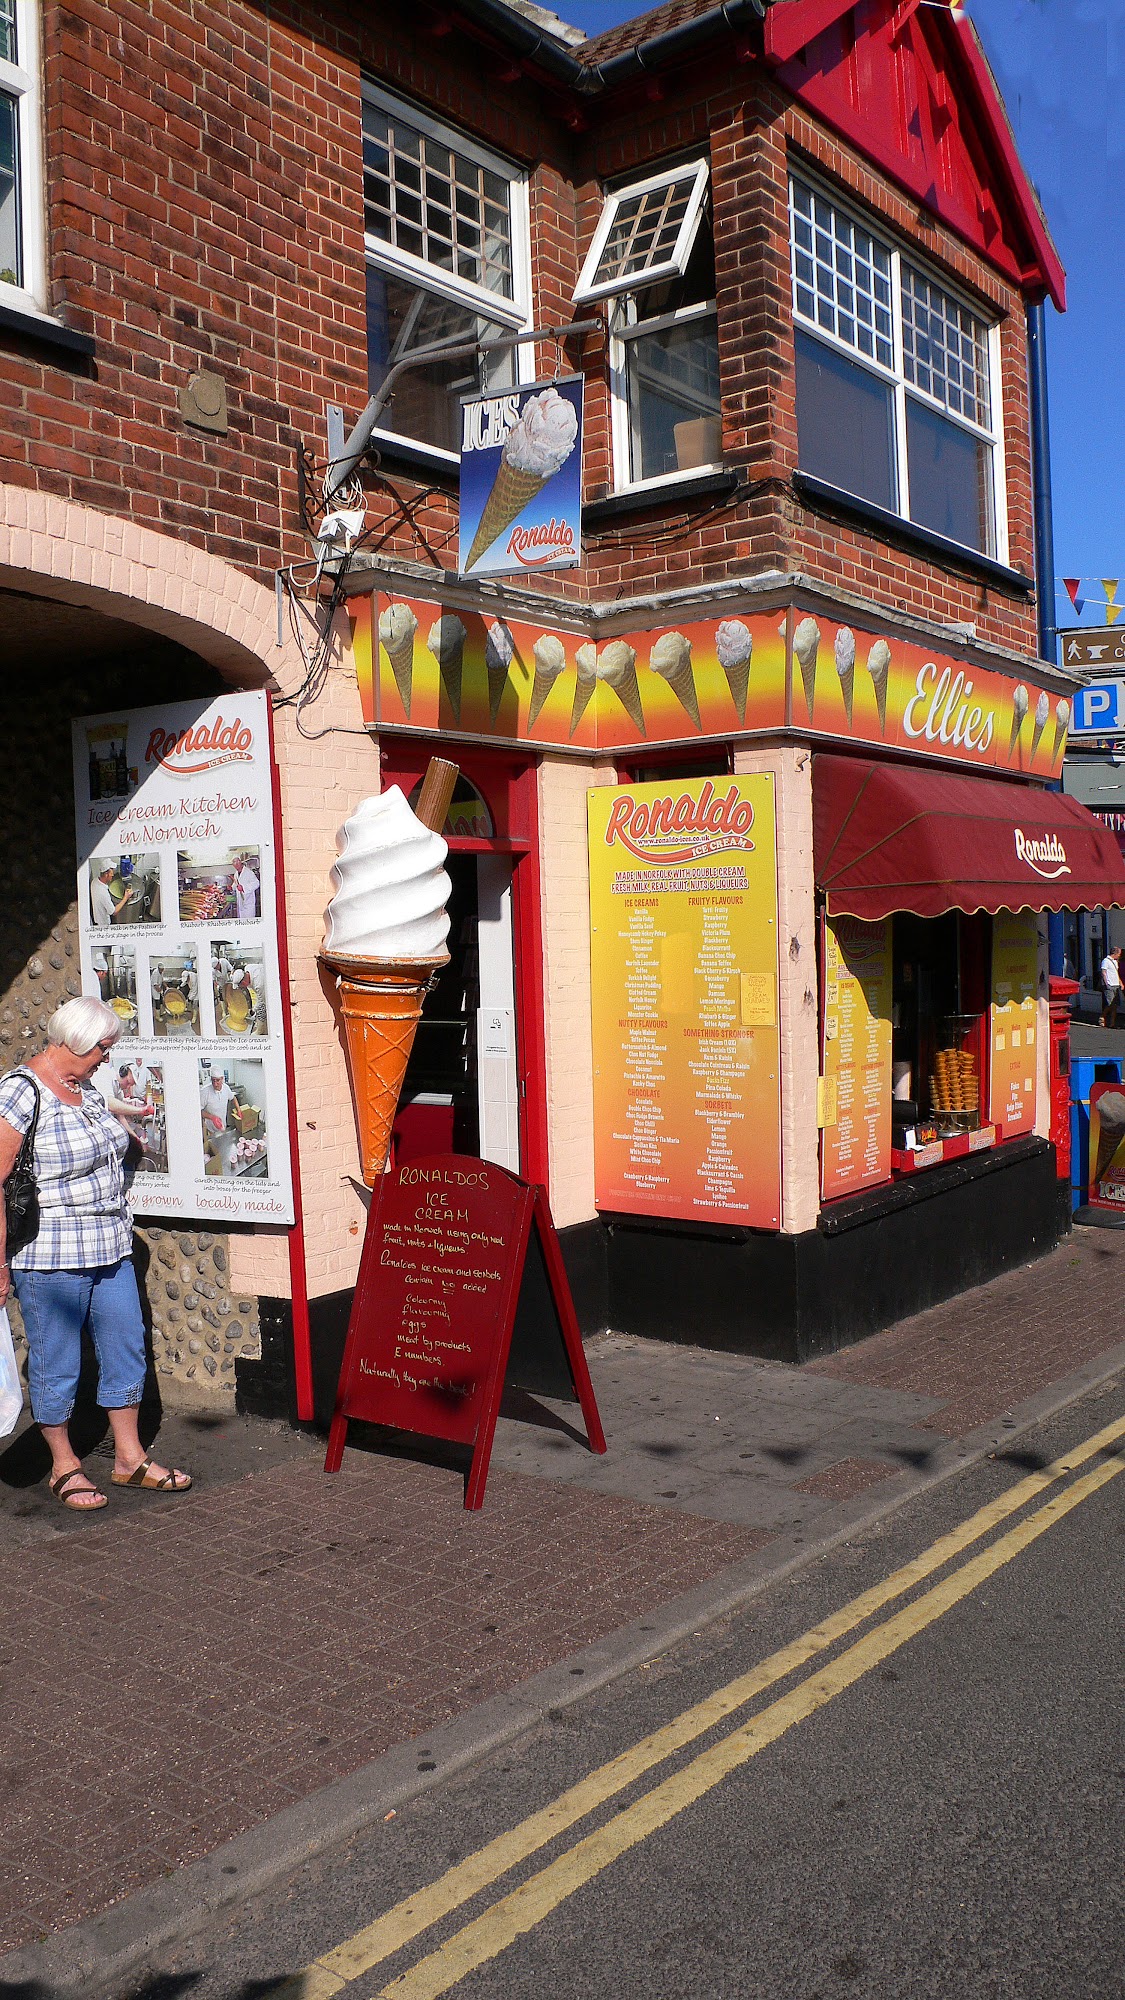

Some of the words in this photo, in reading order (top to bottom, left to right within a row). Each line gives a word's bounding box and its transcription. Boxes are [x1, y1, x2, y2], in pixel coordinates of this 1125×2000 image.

[462, 394, 520, 452] ICES
[507, 518, 574, 554] Ronaldo
[903, 663, 994, 753] Ellies
[1083, 690, 1110, 726] P
[145, 715, 253, 763] Ronaldo
[208, 759, 220, 768] ICE
[221, 752, 249, 764] CREAM
[88, 809, 113, 824] Ice
[117, 805, 177, 821] Cream
[179, 793, 256, 814] Kitchen
[604, 780, 754, 845] Ronaldo
[119, 829, 140, 844] in
[142, 818, 221, 842] Norwich
[637, 834, 710, 846] www.ronaldo-ices.co.uk
[691, 844, 708, 857] ICE
[710, 838, 747, 851] CREAM
[1014, 828, 1067, 863] Ronaldo
[615, 871, 634, 881] MADE
[635, 871, 642, 880] IN
[643, 869, 673, 880] NORFOLK
[673, 868, 691, 879] WITH
[692, 868, 717, 878] DOUBLE
[718, 867, 745, 877] CREAM
[611, 883, 631, 893] FRESH
[632, 882, 650, 893] MILK,
[651, 881, 668, 891] REAL
[669, 881, 690, 891] FRUIT,
[691, 880, 708, 890] NUTS
[709, 880, 715, 889] &
[716, 878, 748, 889] LIQUEURS
[625, 899, 633, 907] ICE
[634, 898, 659, 907] CREAMS
[688, 897, 710, 905] FRUITY
[712, 897, 743, 905] FLAVOURS
[619, 1019, 637, 1027] NUTTY
[639, 1020, 668, 1029] FLAVOURS
[683, 1029, 719, 1037] SOMETHING
[721, 1030, 754, 1038] STRONGER
[628, 1088, 660, 1098] CHOCOLATE
[705, 1101, 732, 1109] SORBETS
[399, 1166, 490, 1190] RONALDOS
[142, 1194, 183, 1207] grown
[196, 1194, 240, 1212] locally
[244, 1199, 284, 1212] made
[426, 1192, 449, 1206] ICE
[415, 1209, 469, 1223] CREAM
[383, 1222, 402, 1232] made
[414, 1224, 443, 1236] Norwich
[447, 1228, 470, 1245] using
[471, 1232, 490, 1246] only
[490, 1235, 505, 1246] real
[397, 1335, 419, 1345] meat
[423, 1336, 433, 1350] by
[435, 1339, 471, 1352] products
